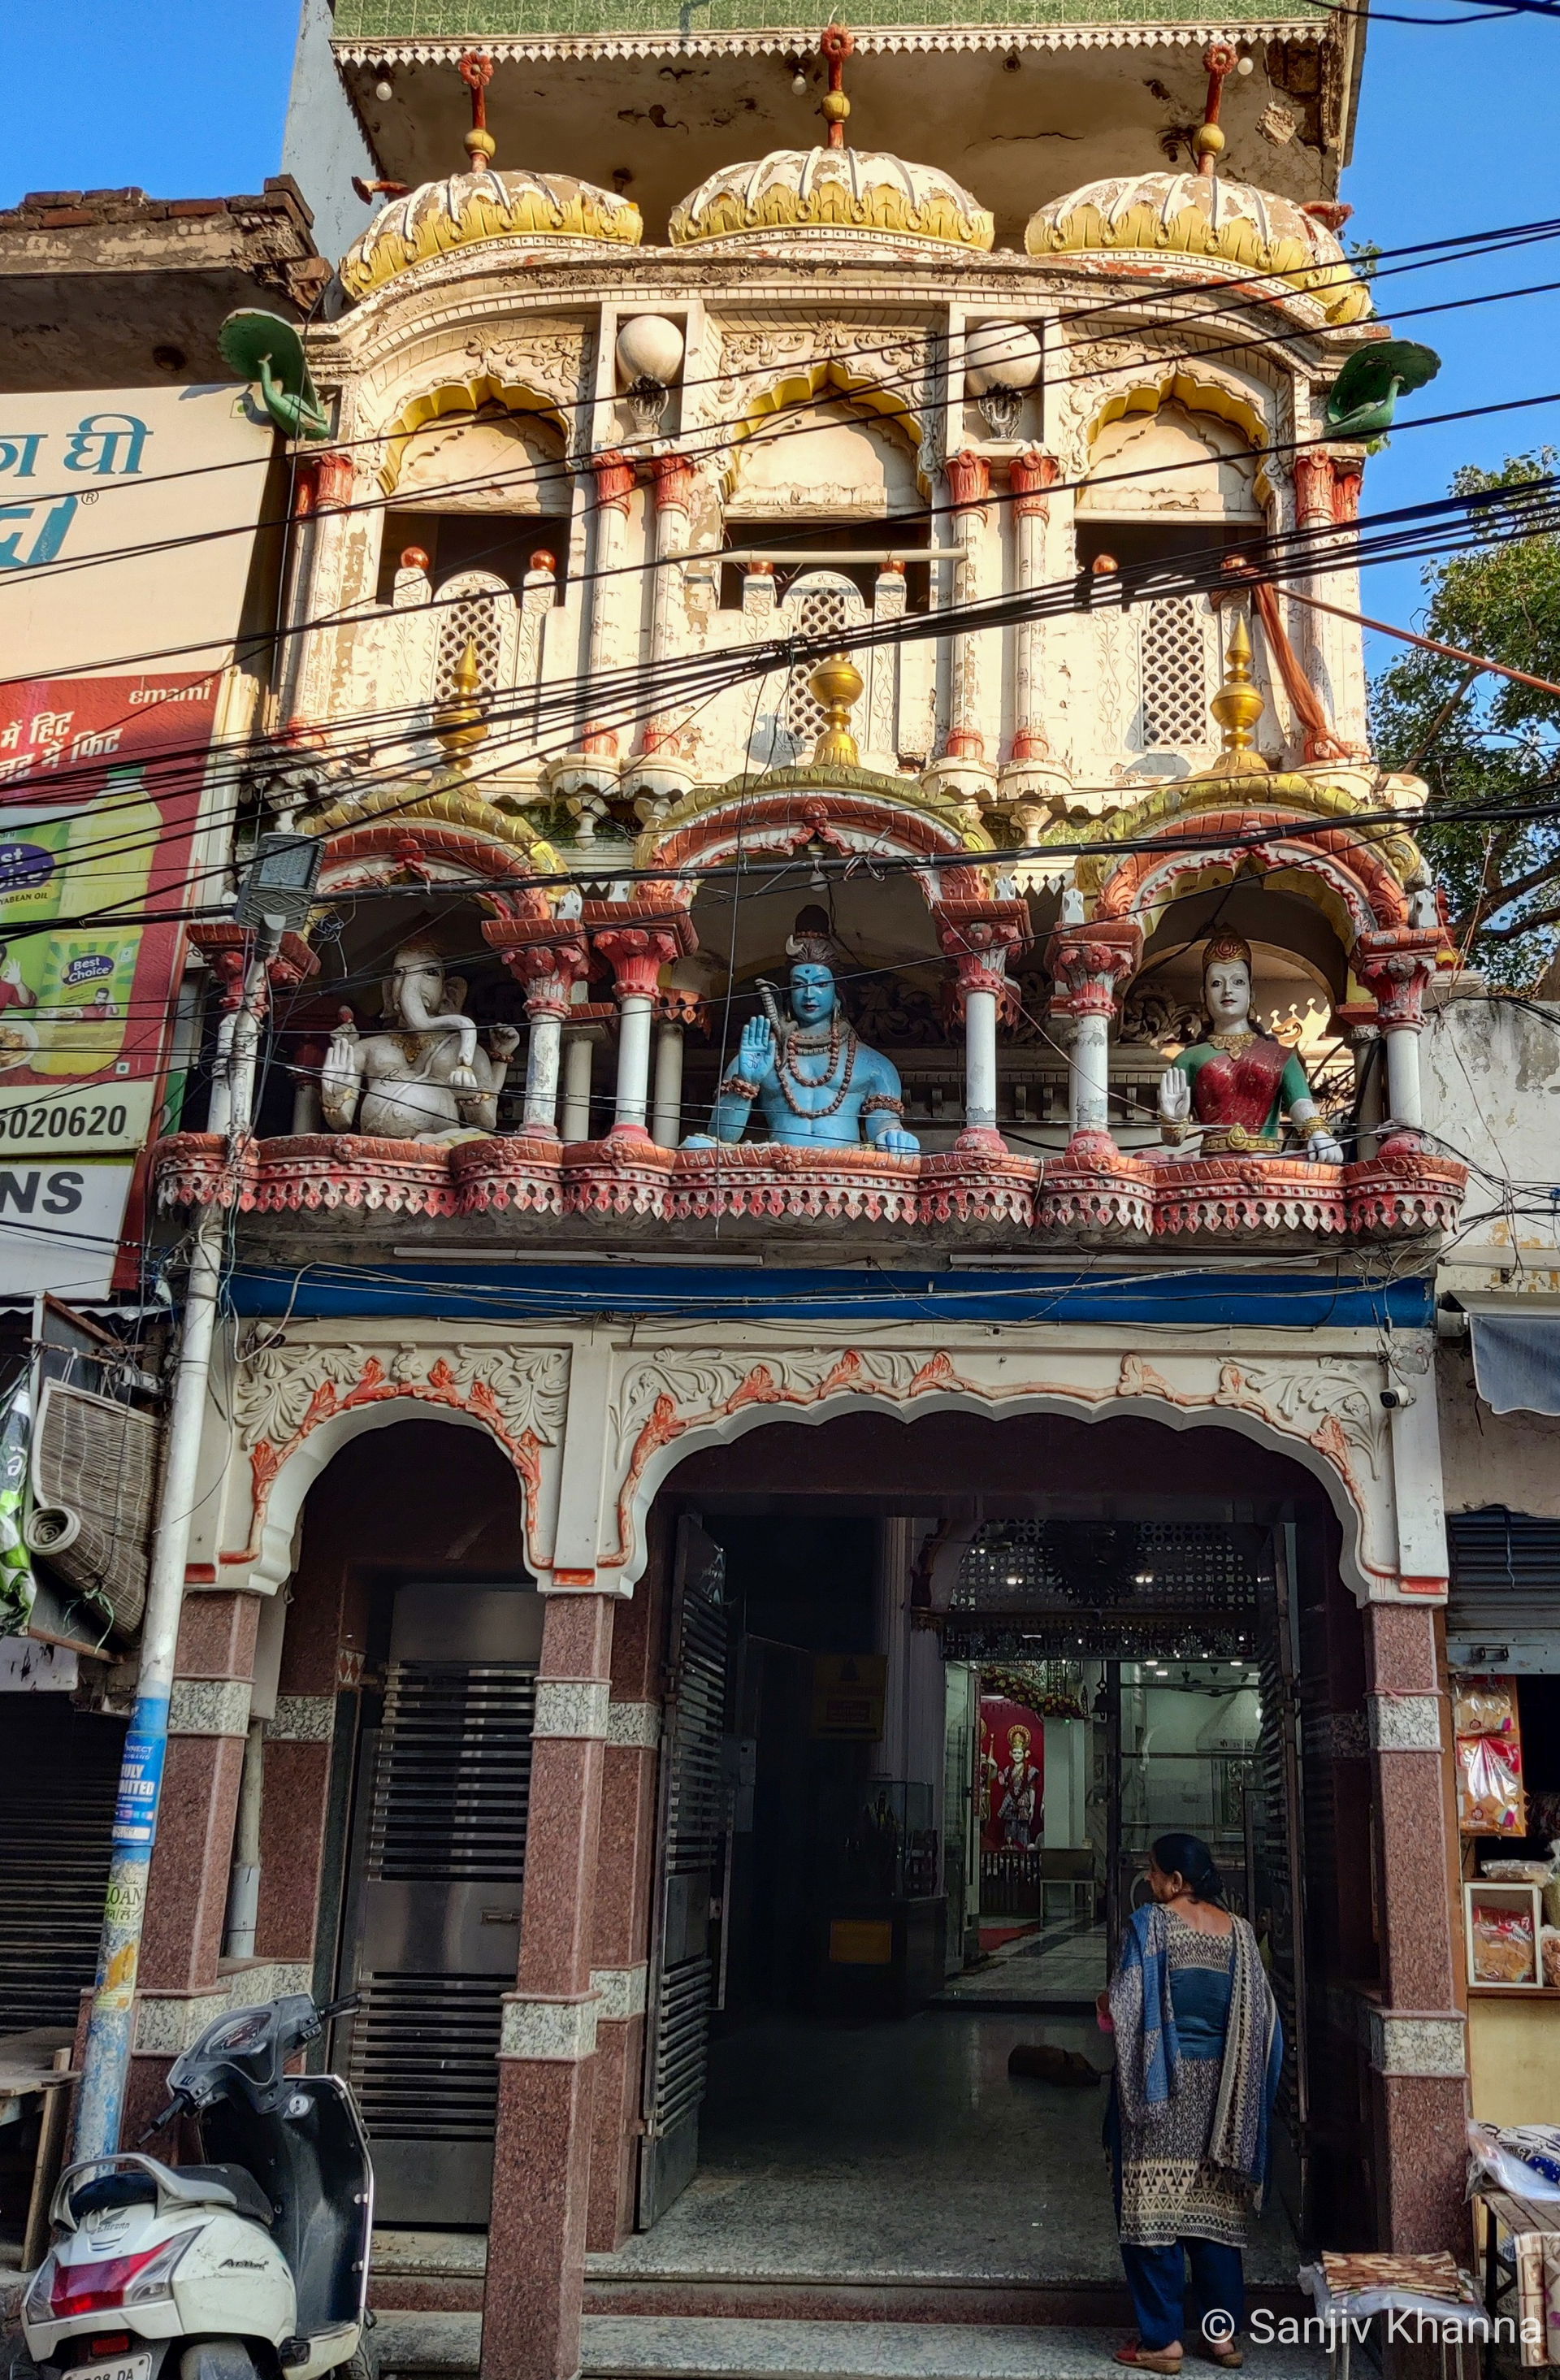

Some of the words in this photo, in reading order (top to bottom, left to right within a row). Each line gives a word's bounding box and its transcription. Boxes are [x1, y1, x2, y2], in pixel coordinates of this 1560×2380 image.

[63, 414, 154, 475] घी
[128, 678, 214, 704] emami
[0, 719, 24, 750] में
[28, 710, 75, 744] हिट
[41, 738, 64, 769] में
[70, 728, 124, 764] फिट
[34, 892, 49, 900] OIL
[68, 966, 110, 982] Choice
[73, 956, 100, 971] Best
